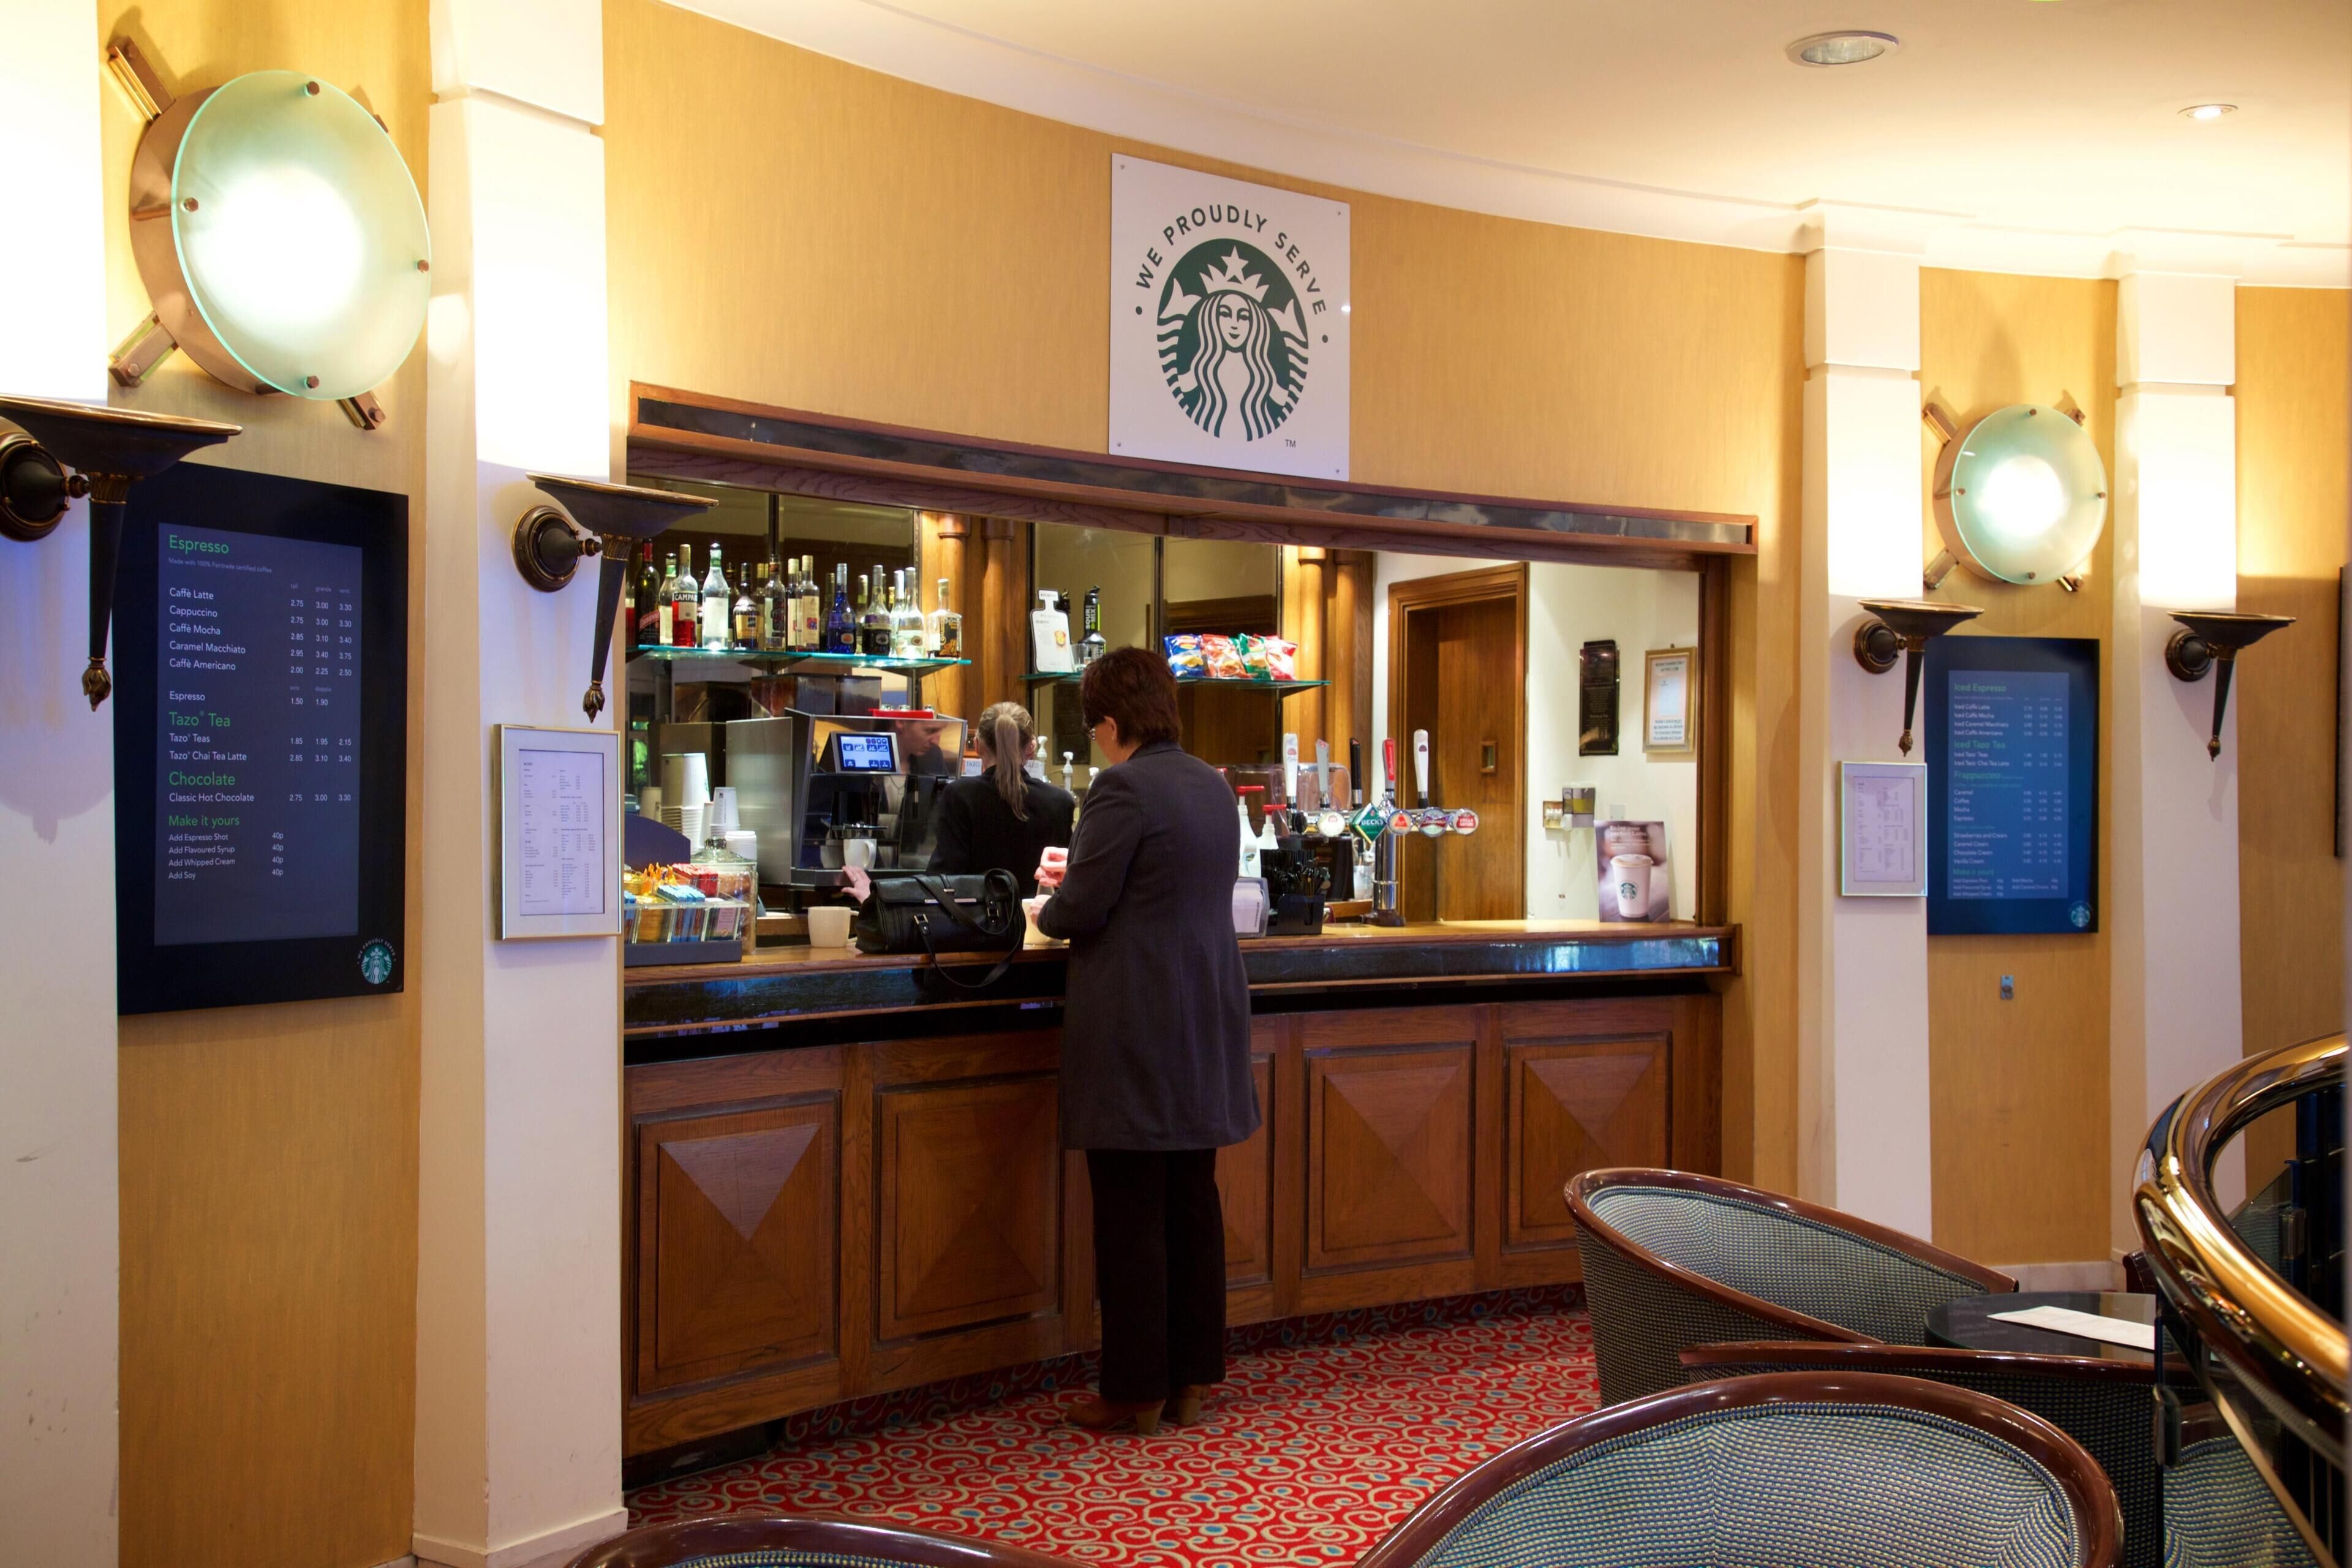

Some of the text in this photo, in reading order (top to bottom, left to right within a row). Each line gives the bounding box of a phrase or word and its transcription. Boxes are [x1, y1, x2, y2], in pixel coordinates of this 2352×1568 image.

[1136, 205, 1326, 315] WE PROUDLY SERVE
[170, 535, 228, 554] Espresso
[170, 588, 214, 600] Caffè Latte
[170, 605, 217, 617] Cappuccino
[170, 623, 221, 635] Caffè Mocha
[170, 641, 246, 654] Caramel Macchiato
[170, 658, 236, 670] Caffè Americano
[1973, 684, 2007, 693] Espresso
[170, 691, 205, 701] Espresso
[209, 714, 230, 727] Tea
[192, 752, 210, 761] Chai
[213, 752, 225, 761] Tea
[227, 752, 247, 761] Latte
[170, 771, 235, 785] Chocolate
[170, 793, 196, 802] Classic
[169, 815, 239, 828] Make it yours
[185, 834, 213, 842] Espresso
[217, 845, 235, 854] Syrup
[184, 858, 213, 867] Whipped
[184, 872, 195, 880] Soy
